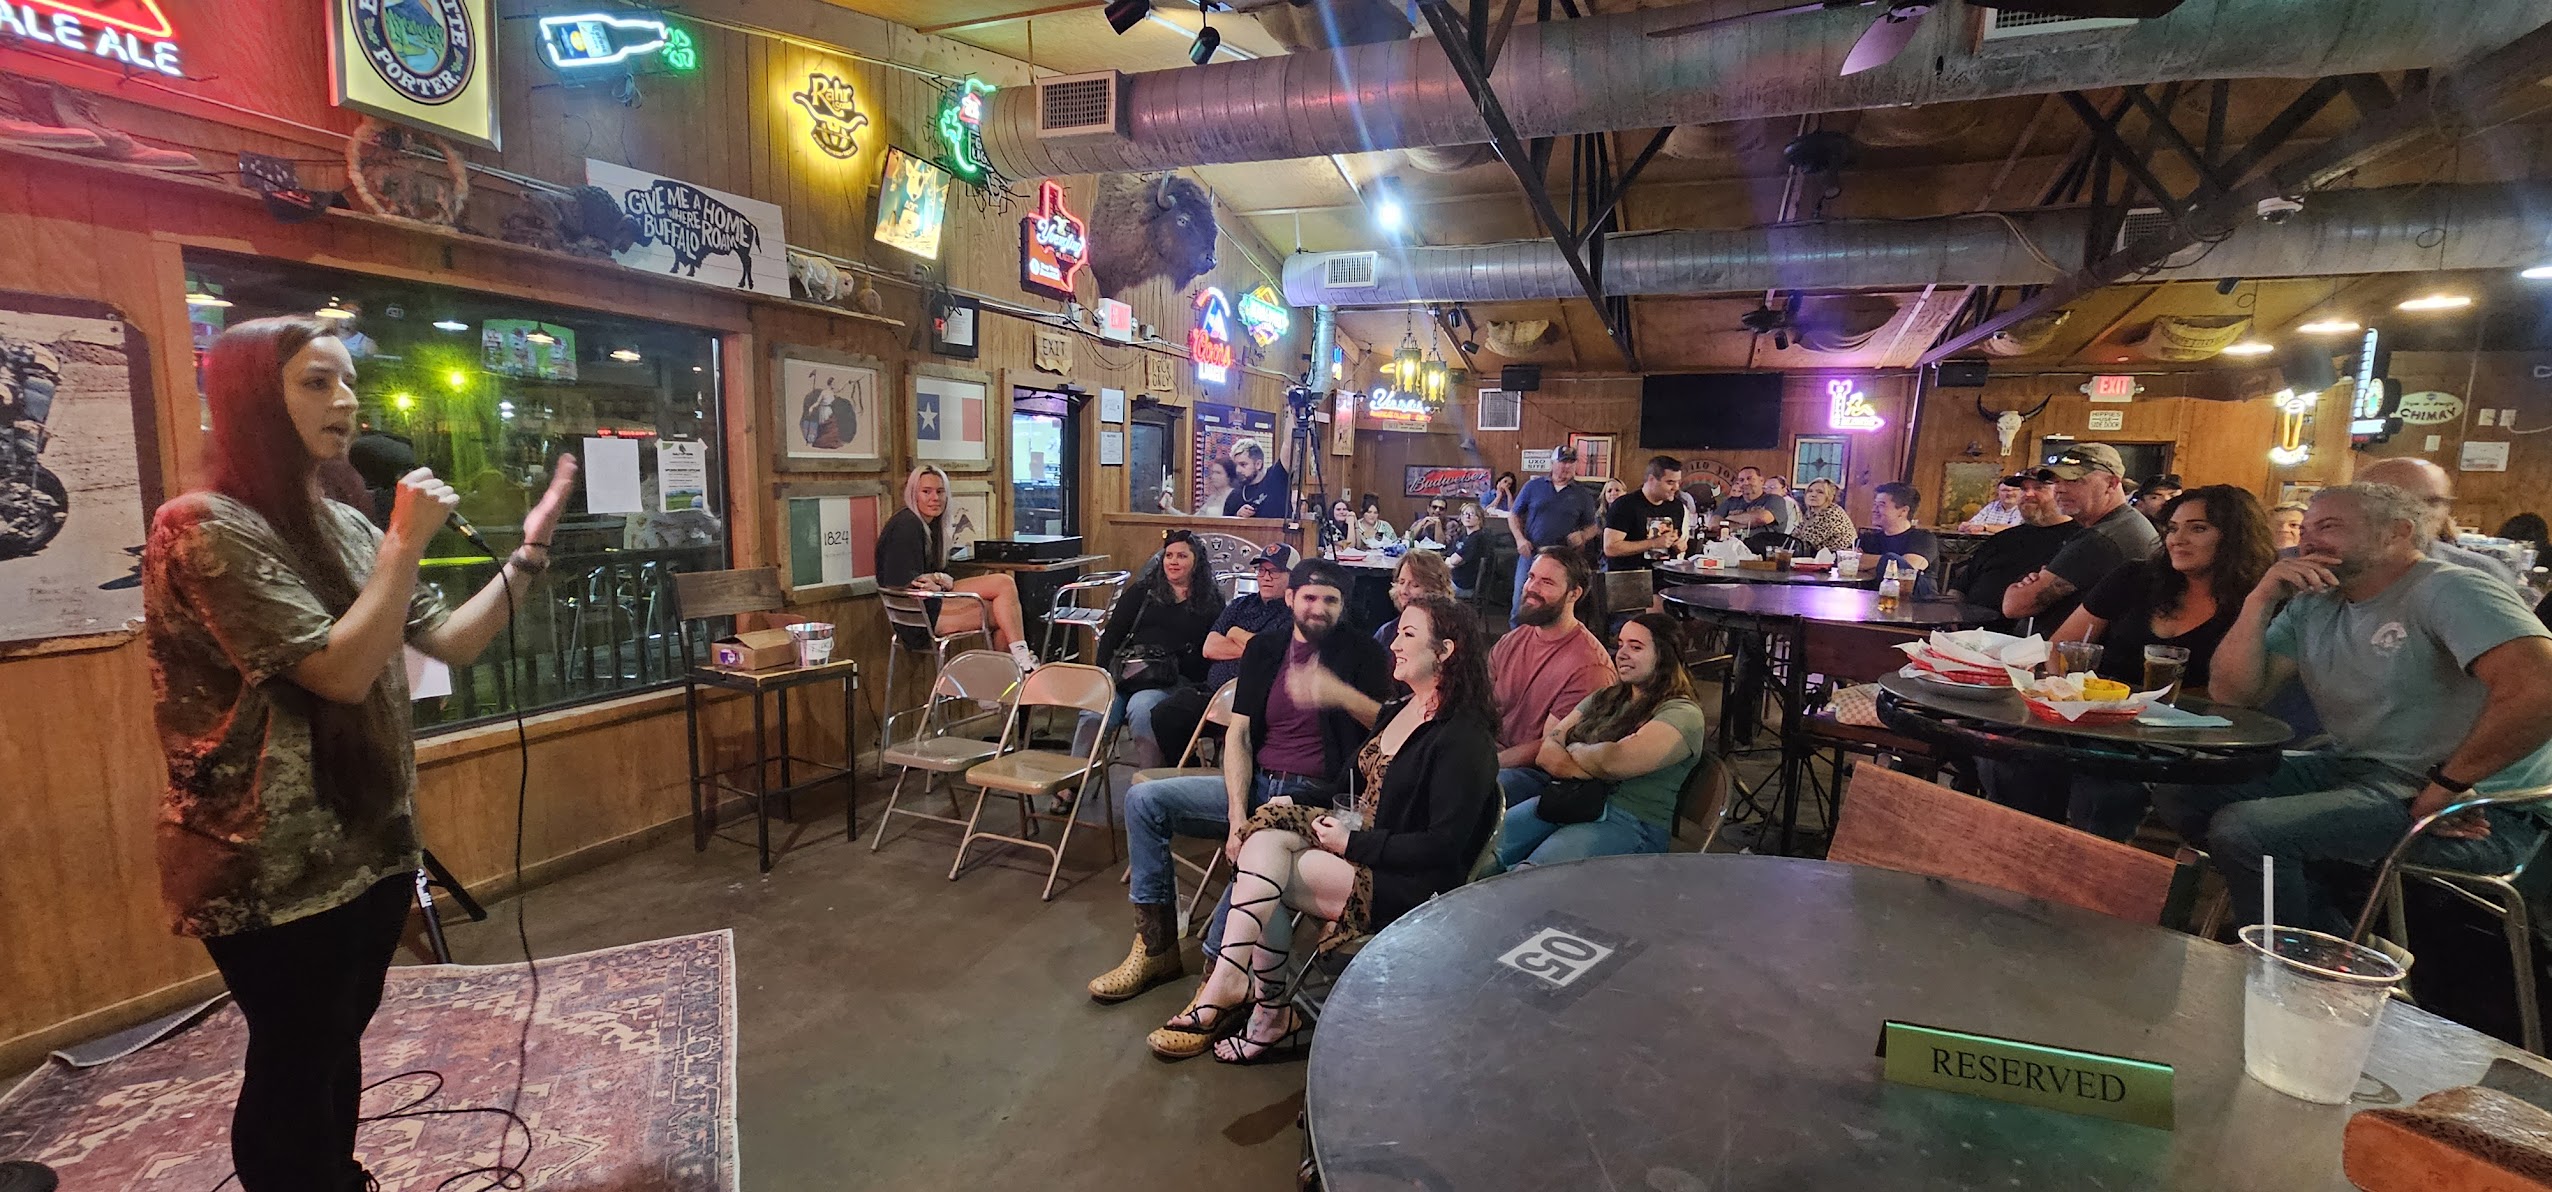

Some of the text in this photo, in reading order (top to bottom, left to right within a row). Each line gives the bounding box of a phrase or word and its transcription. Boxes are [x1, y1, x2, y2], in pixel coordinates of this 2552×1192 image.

[95, 26, 183, 77] ALE
[810, 77, 850, 117] Rahr
[667, 186, 690, 210] ME
[693, 194, 701, 210] A
[703, 198, 751, 248] HOME
[667, 208, 701, 230] WHERE
[644, 213, 739, 261] BUFFALO ROAM
[1042, 338, 1065, 357] EXIT
[1192, 328, 1231, 368] Coors
[1152, 358, 1171, 373] DECK
[1152, 373, 1171, 388] ONLY
[2099, 379, 2128, 395] EXIT
[2400, 407, 2456, 421] CHIMAY
[1409, 470, 1489, 493] Budweiser
[824, 531, 849, 546] 1824
[1514, 936, 1598, 981] 05
[1930, 1046, 2126, 1103] RESERVED
